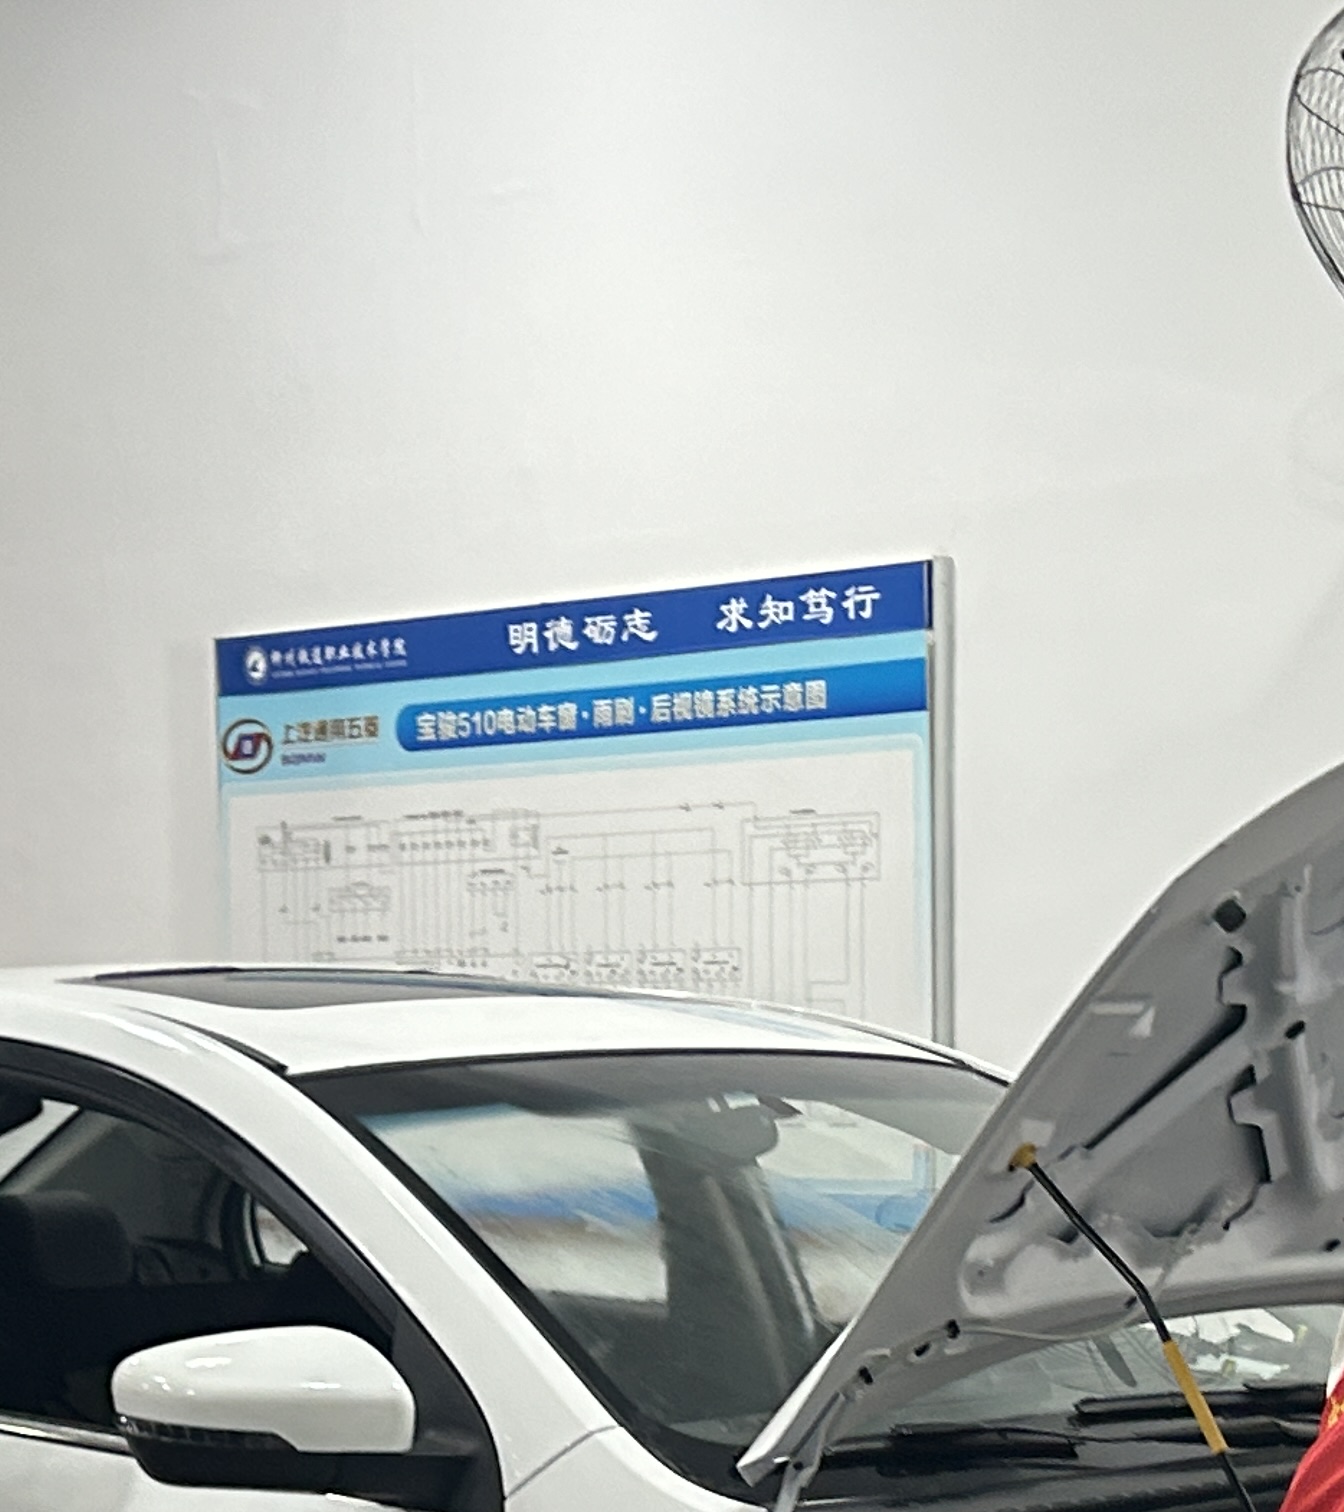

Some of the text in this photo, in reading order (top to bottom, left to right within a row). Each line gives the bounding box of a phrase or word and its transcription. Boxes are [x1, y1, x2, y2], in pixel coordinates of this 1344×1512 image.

[507, 583, 882, 657] 明德砺志 求知笃行
